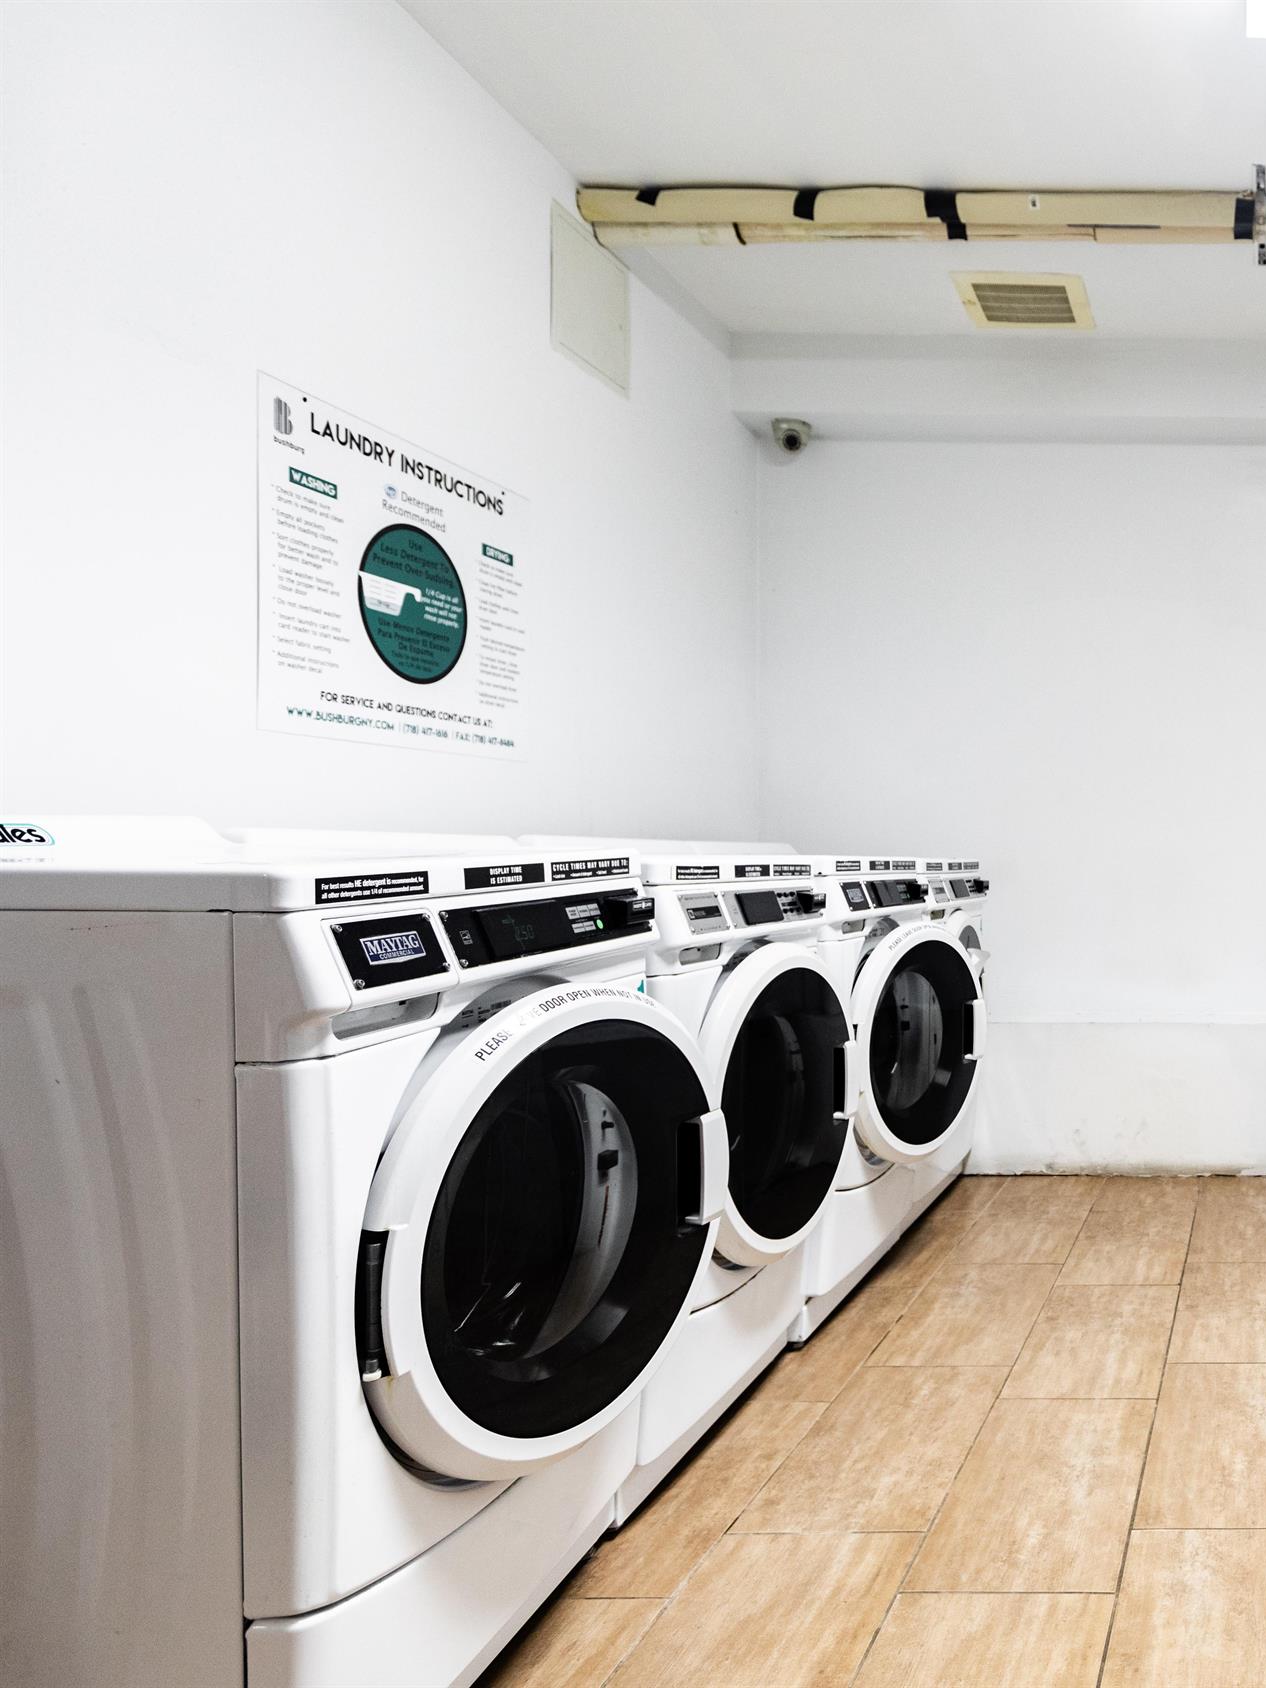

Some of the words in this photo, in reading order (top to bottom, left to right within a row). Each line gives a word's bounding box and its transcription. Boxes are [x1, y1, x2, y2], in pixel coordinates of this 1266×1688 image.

[311, 411, 395, 467] LAUNDRY
[401, 453, 504, 516] INSTRUCTIONS
[290, 468, 337, 497] WASHING
[401, 491, 445, 517] Detergent
[381, 498, 447, 534] Recommended
[408, 540, 423, 553] Use
[373, 552, 403, 571] Prevent
[381, 543, 399, 557] Less
[400, 550, 438, 572] Detergent
[425, 587, 436, 597] 1/4
[286, 704, 394, 731] WWW.BUSHBURGNY.COM
[320, 690, 339, 703] FOR
[340, 694, 376, 710] SERVICE
[377, 701, 394, 713] AND
[395, 703, 437, 720] QUESTIONS
[437, 711, 472, 725] CONTACT
[473, 716, 482, 727] US
[483, 719, 495, 730] AT:
[0, 824, 46, 843] les
[489, 867, 510, 876] DISPLAY
[511, 866, 523, 874] TIME
[552, 863, 569, 872] CYCLE
[570, 862, 586, 870] TIMES
[587, 861, 597, 869] MAY
[598, 860, 610, 868] VARY
[611, 859, 620, 867] DUE
[329, 882, 340, 890] best
[340, 881, 354, 889] results
[355, 879, 363, 888] HE
[363, 878, 386, 888] detergent
[387, 877, 392, 885] is
[490, 877, 497, 885] IS
[497, 875, 523, 884] ESTIMATED
[328, 891, 340, 899] other
[340, 890, 362, 898] detergents
[364, 934, 420, 956] MAYTAG
[379, 949, 415, 960] COMMERCIAL
[538, 995, 568, 1013] DOOR
[566, 989, 592, 1001] OPEN
[592, 988, 617, 998] WHEN
[617, 989, 632, 1000] NOT
